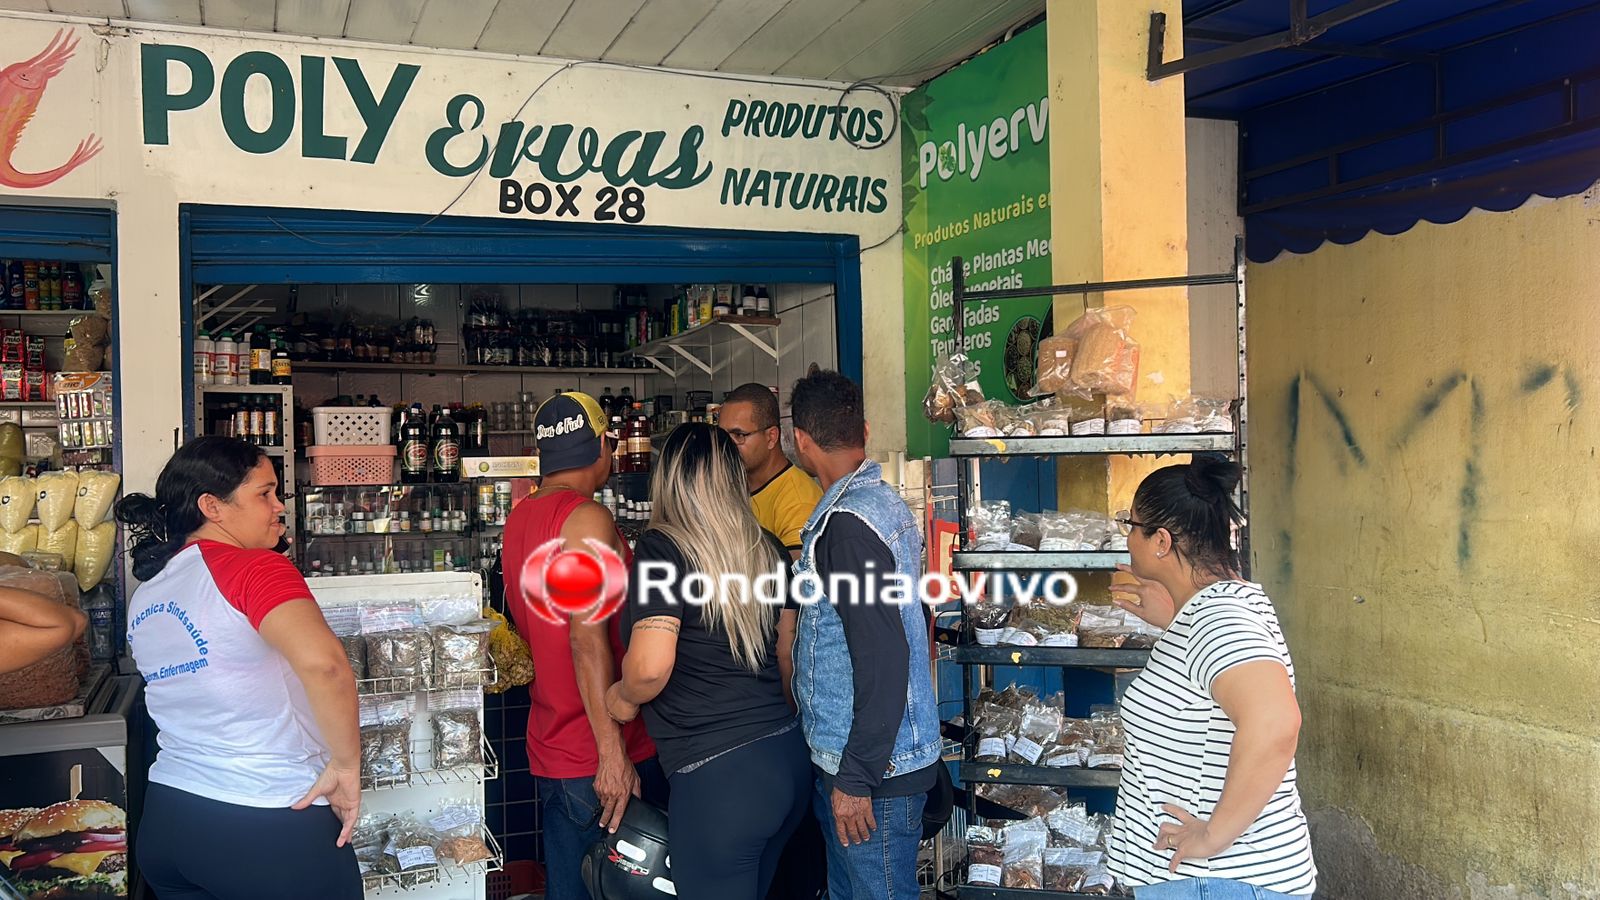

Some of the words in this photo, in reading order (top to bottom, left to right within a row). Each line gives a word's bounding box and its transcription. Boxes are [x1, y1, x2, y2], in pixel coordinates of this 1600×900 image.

[140, 43, 422, 164] POLY
[424, 93, 713, 190] Ervas
[721, 98, 884, 143] PRODUTOS
[499, 178, 582, 217] BOX
[593, 185, 646, 224] 28
[719, 167, 888, 214] NATURAIS
[914, 218, 970, 250] Produtos
[973, 194, 1034, 231] Naturais
[1038, 193, 1051, 210] e
[930, 258, 953, 287] Chá
[973, 246, 1024, 275] Plantas
[930, 286, 954, 311] Óle
[964, 269, 1023, 303] etais
[930, 304, 1000, 336] Garfadas
[930, 330, 992, 357] Temeros
[166, 601, 209, 656] Sindsaúde
[159, 657, 209, 680] Enfermagem
